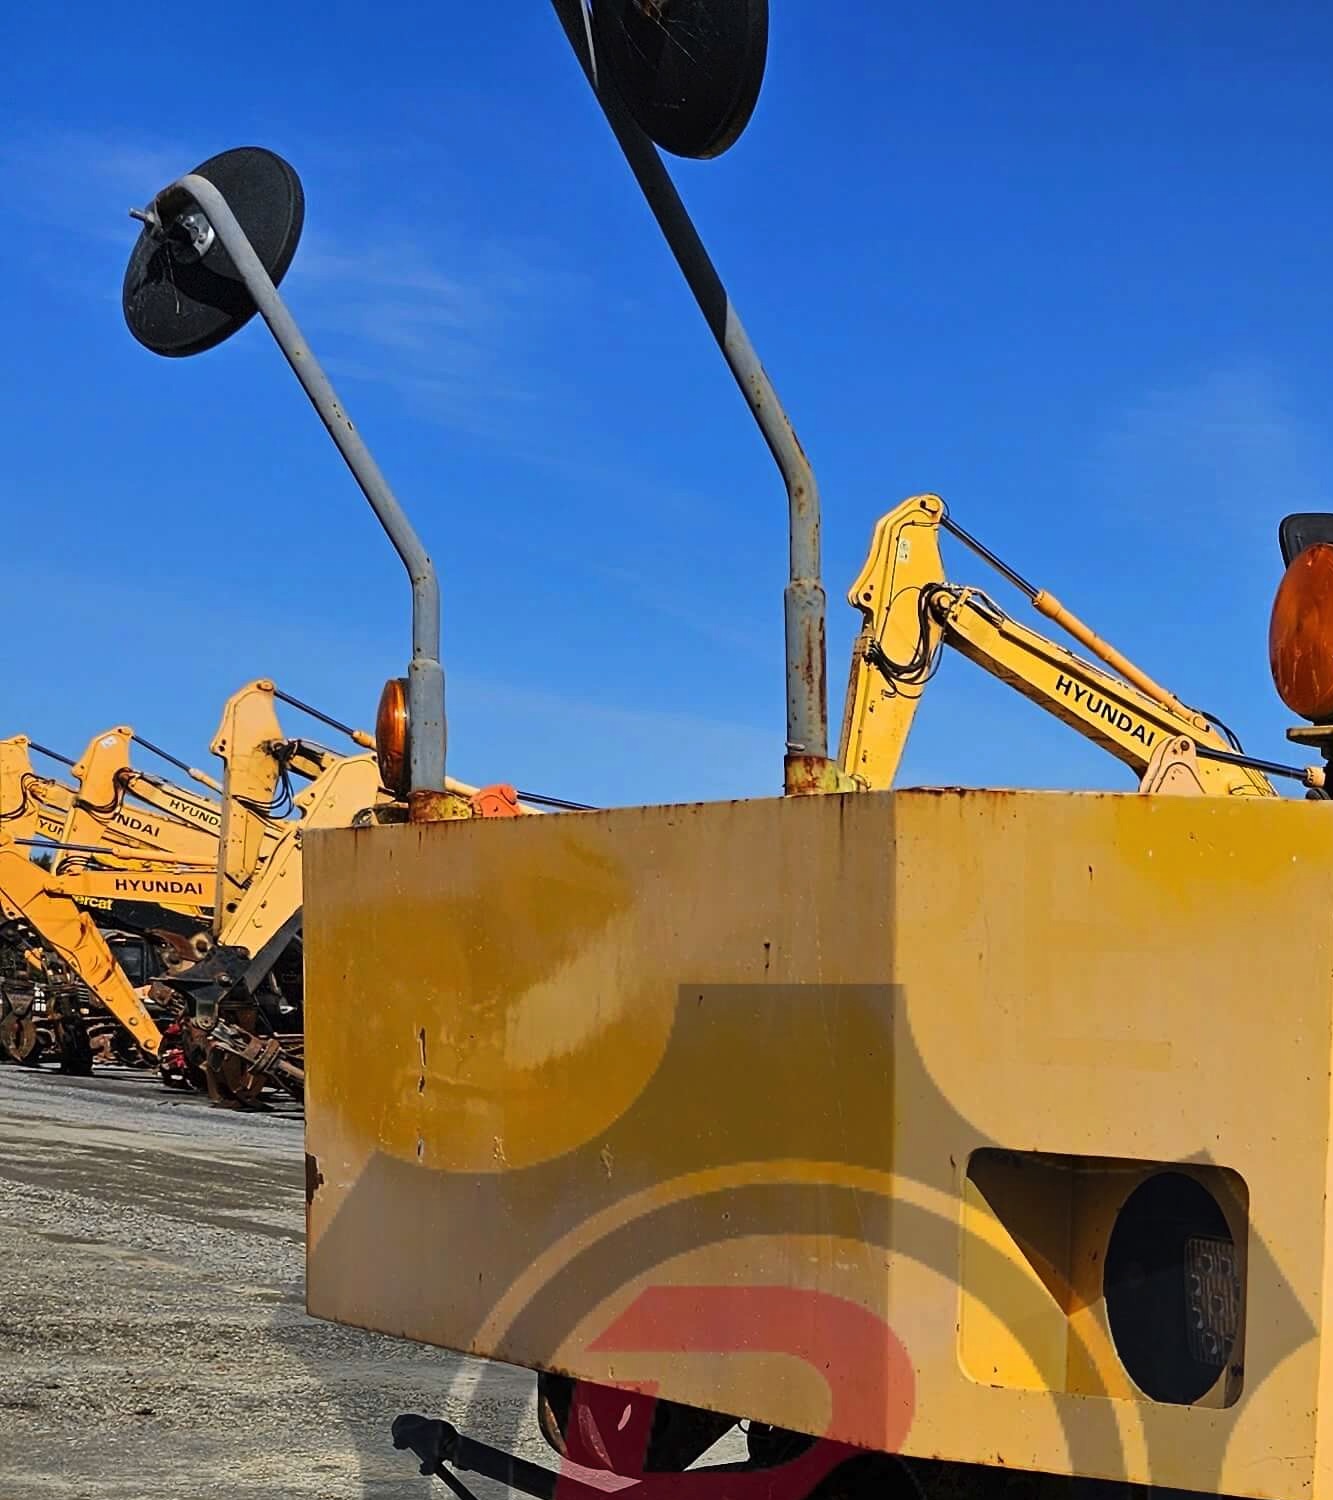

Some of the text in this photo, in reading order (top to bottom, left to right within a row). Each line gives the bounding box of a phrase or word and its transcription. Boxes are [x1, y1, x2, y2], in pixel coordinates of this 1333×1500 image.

[1056, 674, 1155, 747] HYUNDAI
[169, 799, 221, 828] HYUND
[115, 878, 203, 895] HYUNDAI
